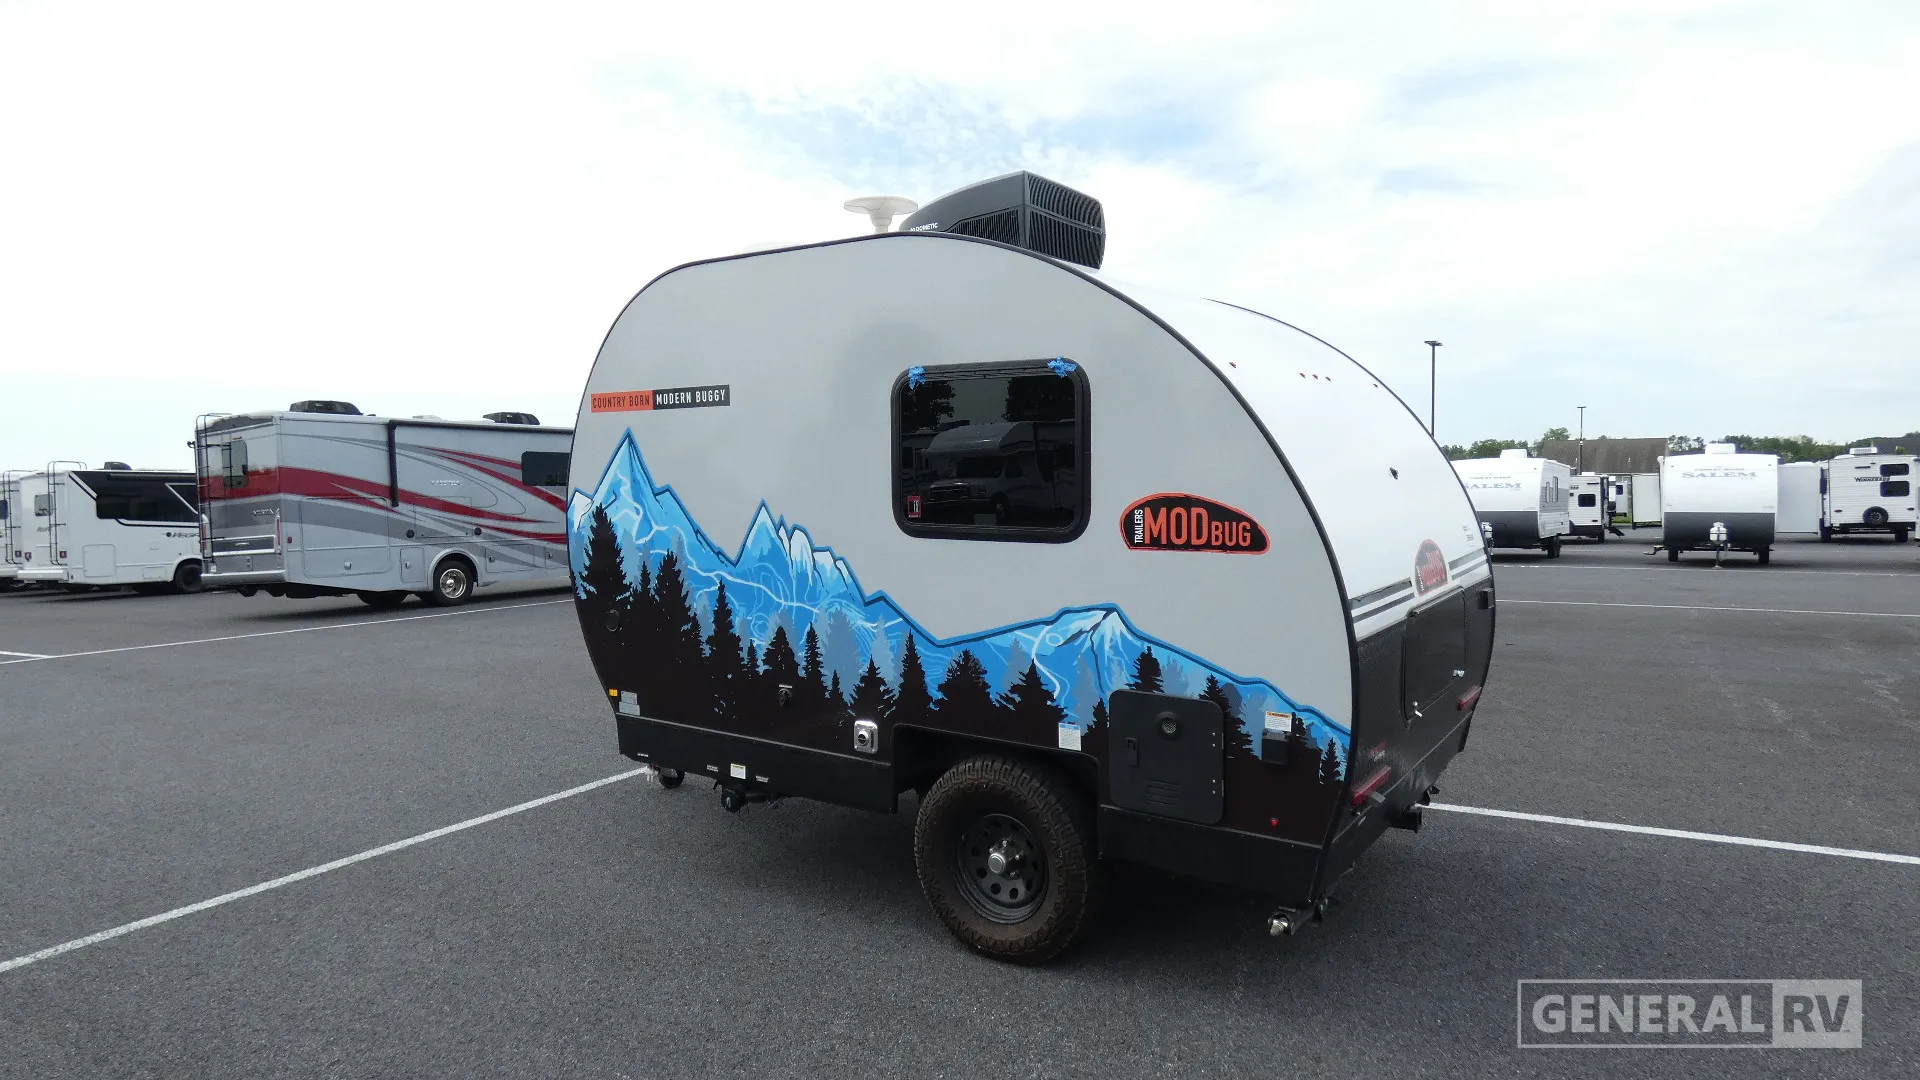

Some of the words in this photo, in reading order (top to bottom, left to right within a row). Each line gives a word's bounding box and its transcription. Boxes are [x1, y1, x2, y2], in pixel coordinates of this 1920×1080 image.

[592, 396, 626, 409] COUNTRY
[629, 394, 650, 407] BORN
[656, 391, 692, 405] MODERN
[695, 389, 726, 402] BUGGY
[1134, 509, 1144, 544] TRAILERS
